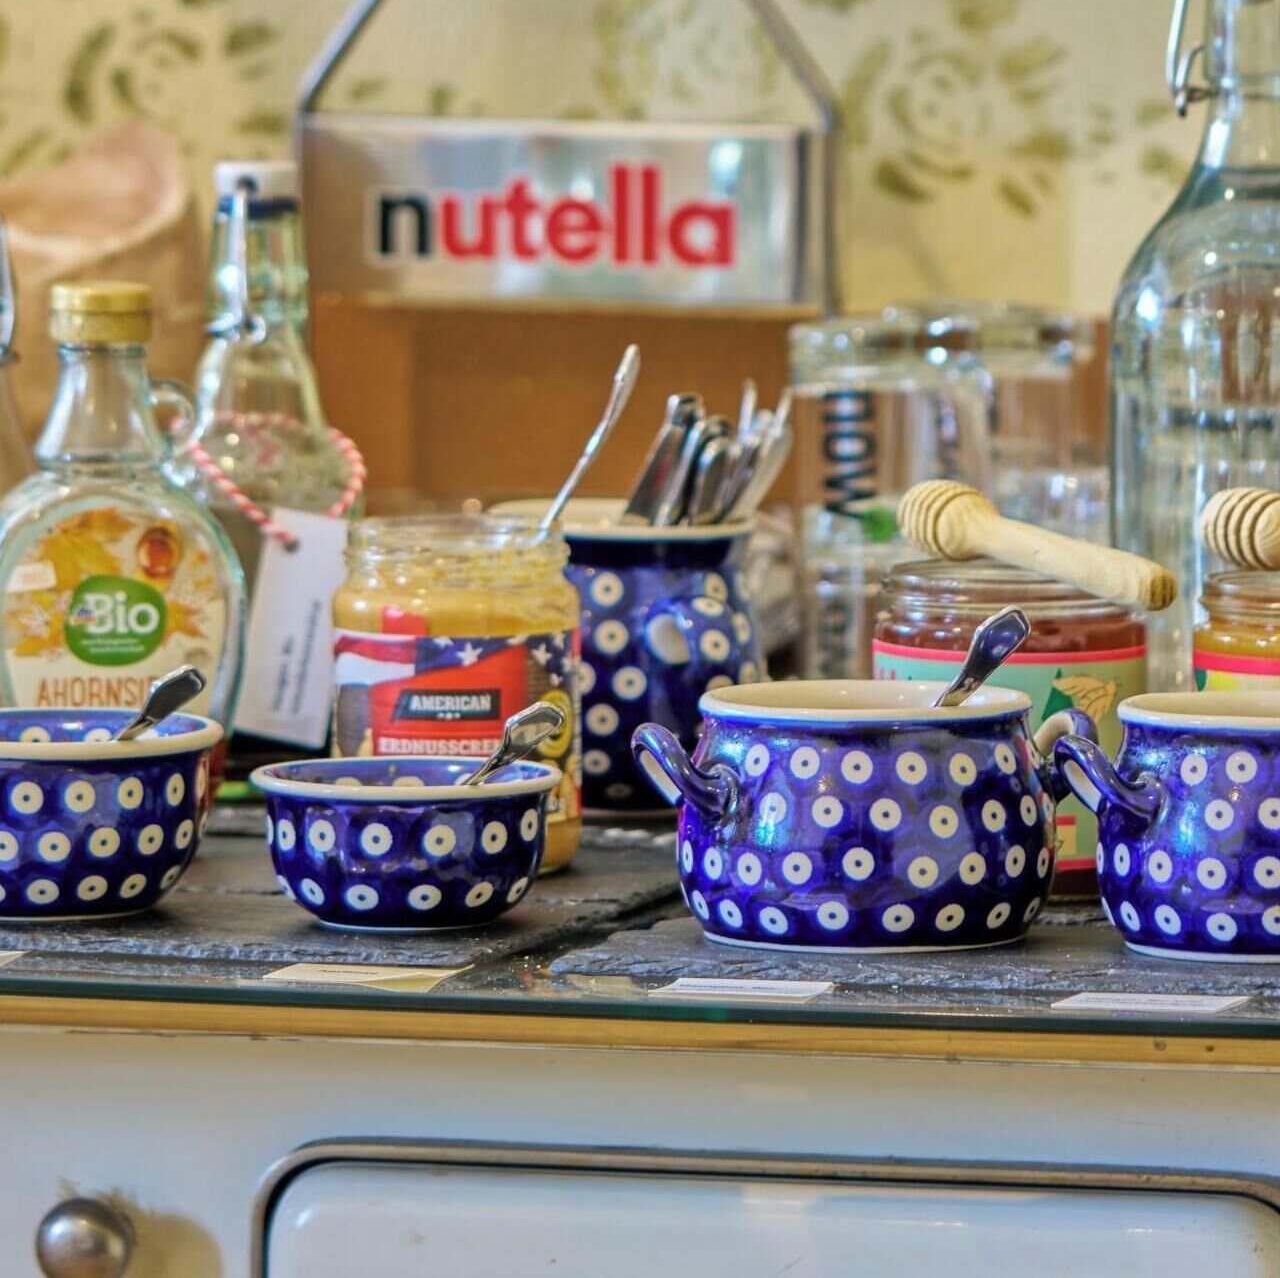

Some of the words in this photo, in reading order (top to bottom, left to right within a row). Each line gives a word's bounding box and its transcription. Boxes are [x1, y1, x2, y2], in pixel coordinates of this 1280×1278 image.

[378, 163, 735, 265] nutella
[84, 591, 161, 635] Bio
[37, 675, 160, 707] AHORNSI
[409, 694, 492, 711] AMERICAN
